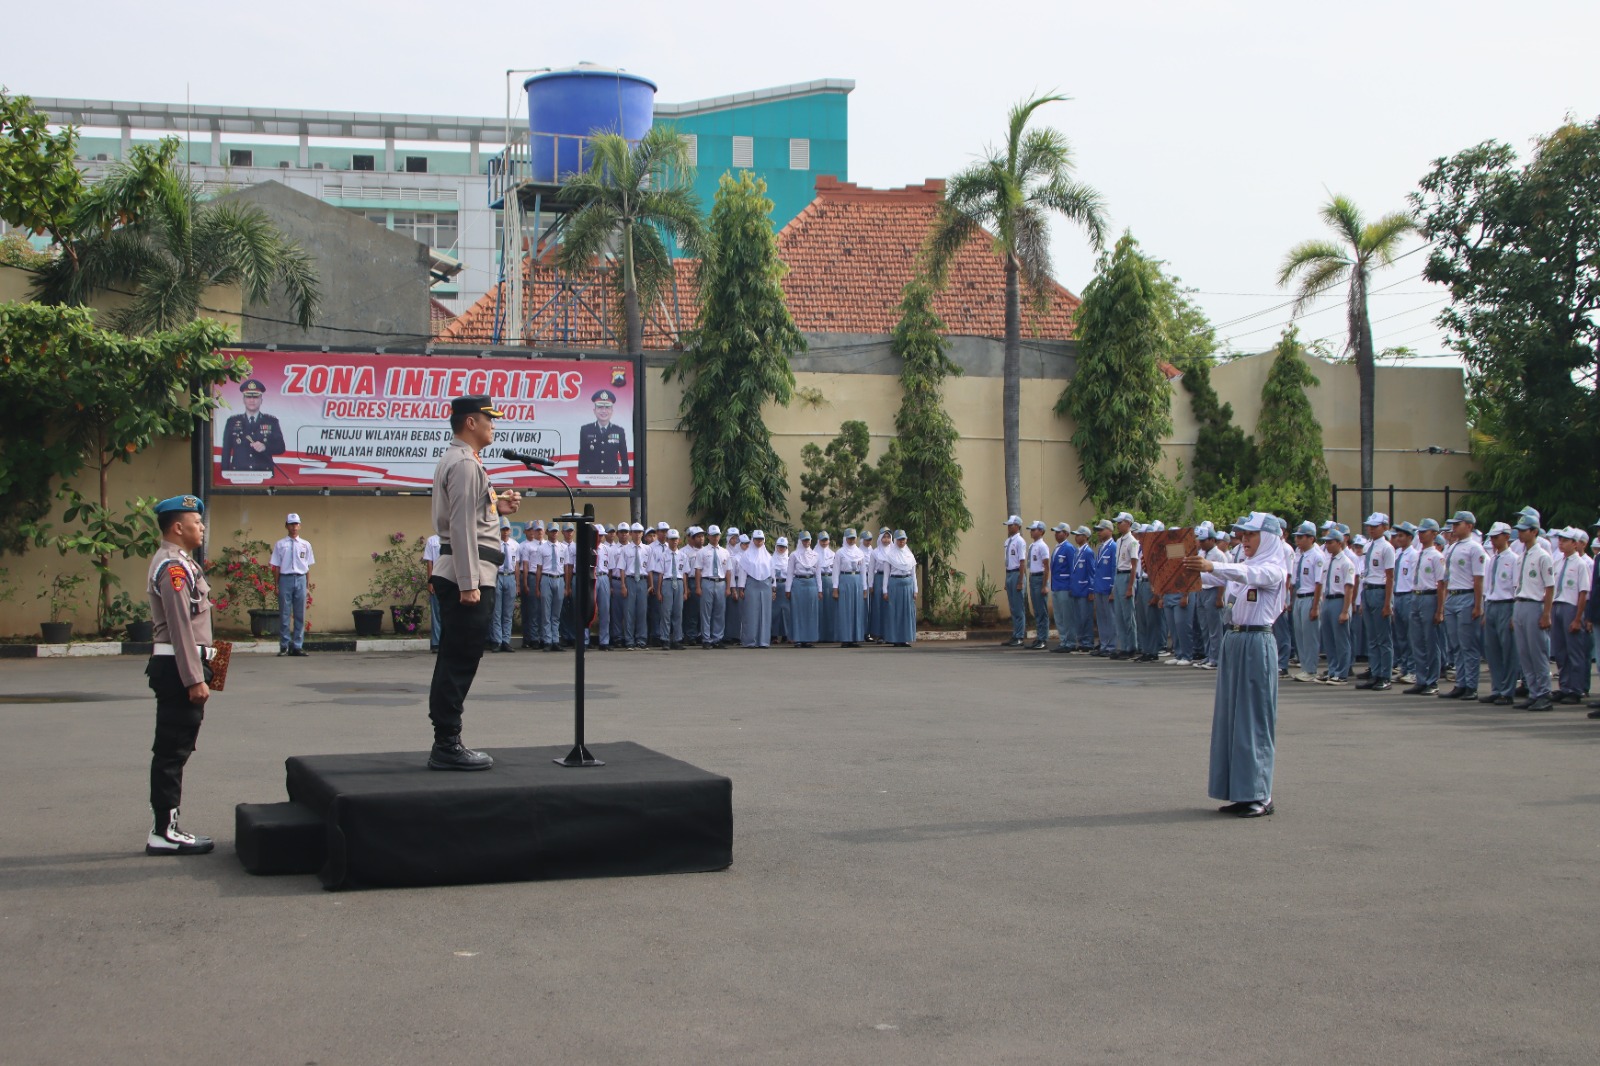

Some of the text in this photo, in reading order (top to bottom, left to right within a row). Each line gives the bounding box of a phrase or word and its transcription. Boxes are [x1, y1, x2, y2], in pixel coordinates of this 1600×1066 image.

[283, 365, 582, 400] ZONA INTEGRITAS
[324, 400, 536, 421] POLRES PEKALO KOTA
[320, 428, 363, 440] MENUJU
[365, 429, 409, 441] WILAYAH
[410, 430, 442, 441] BEBAS
[511, 431, 542, 444] (WBK)
[305, 445, 327, 457] DAN
[330, 446, 374, 457] WILAYAH
[375, 446, 428, 458] BIROKRASI
